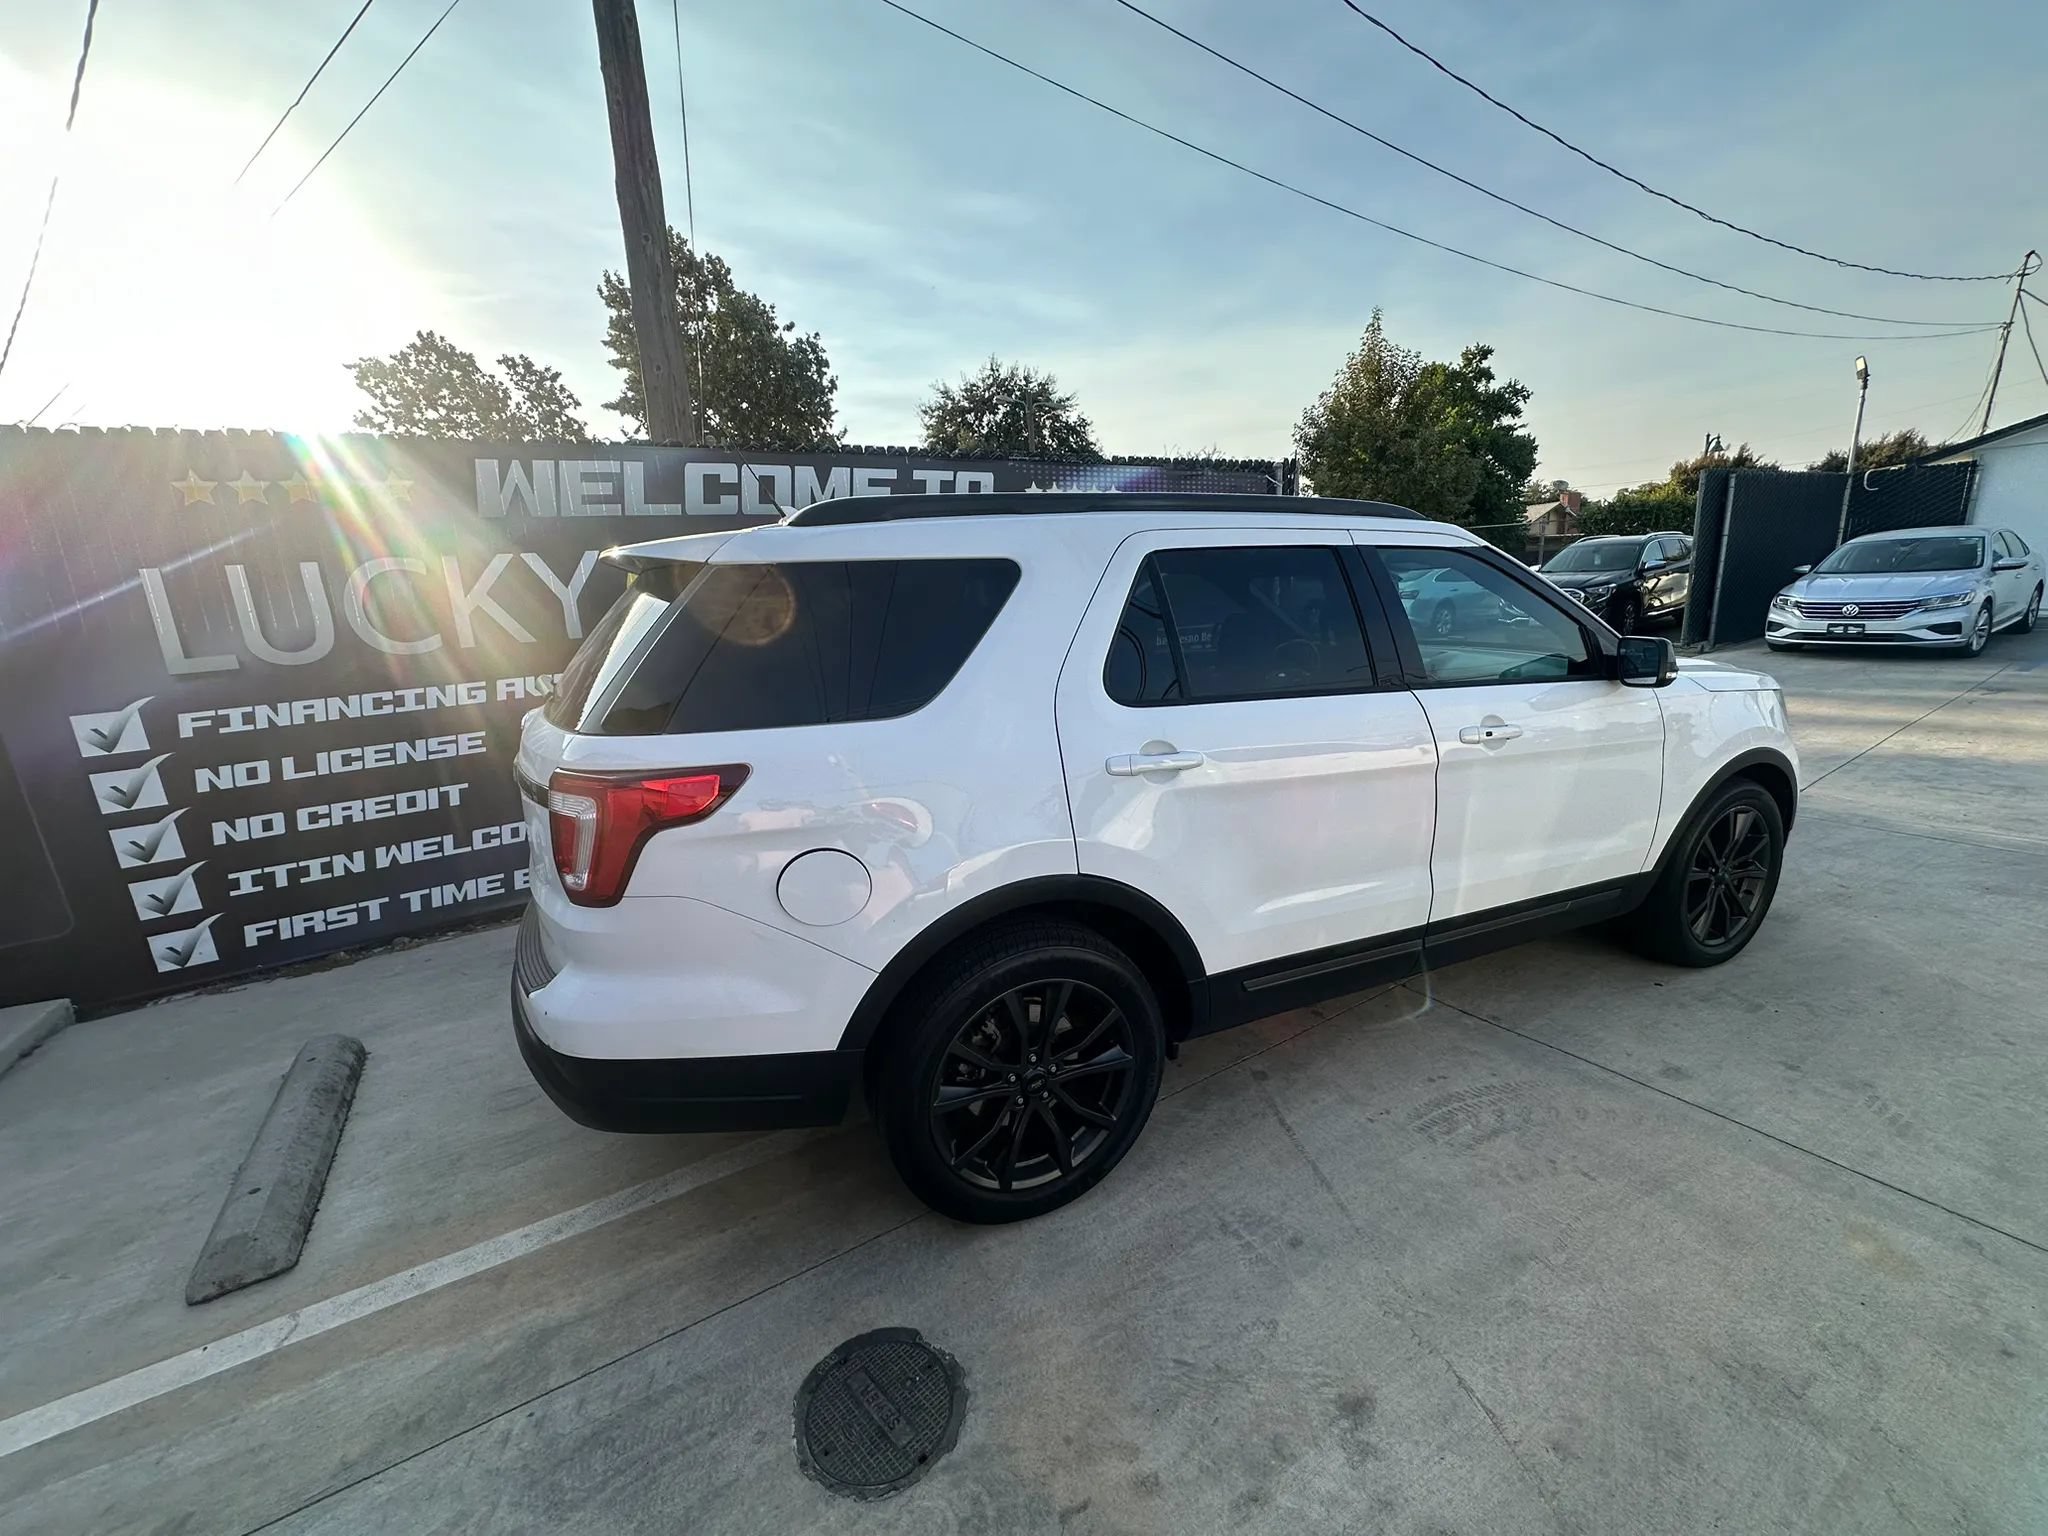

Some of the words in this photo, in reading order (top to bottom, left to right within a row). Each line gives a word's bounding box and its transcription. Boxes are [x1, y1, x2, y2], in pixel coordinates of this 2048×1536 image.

[474, 458, 897, 518] WELCOME
[139, 550, 600, 675] LUCKY
[177, 681, 486, 738] FINANCING
[195, 759, 271, 793] NO
[281, 731, 486, 780] LICENSE
[211, 813, 286, 846] NO
[296, 783, 468, 832] CREDIT
[227, 856, 365, 896] ITIN
[244, 897, 389, 947] FIRST
[400, 873, 505, 911] TIME
